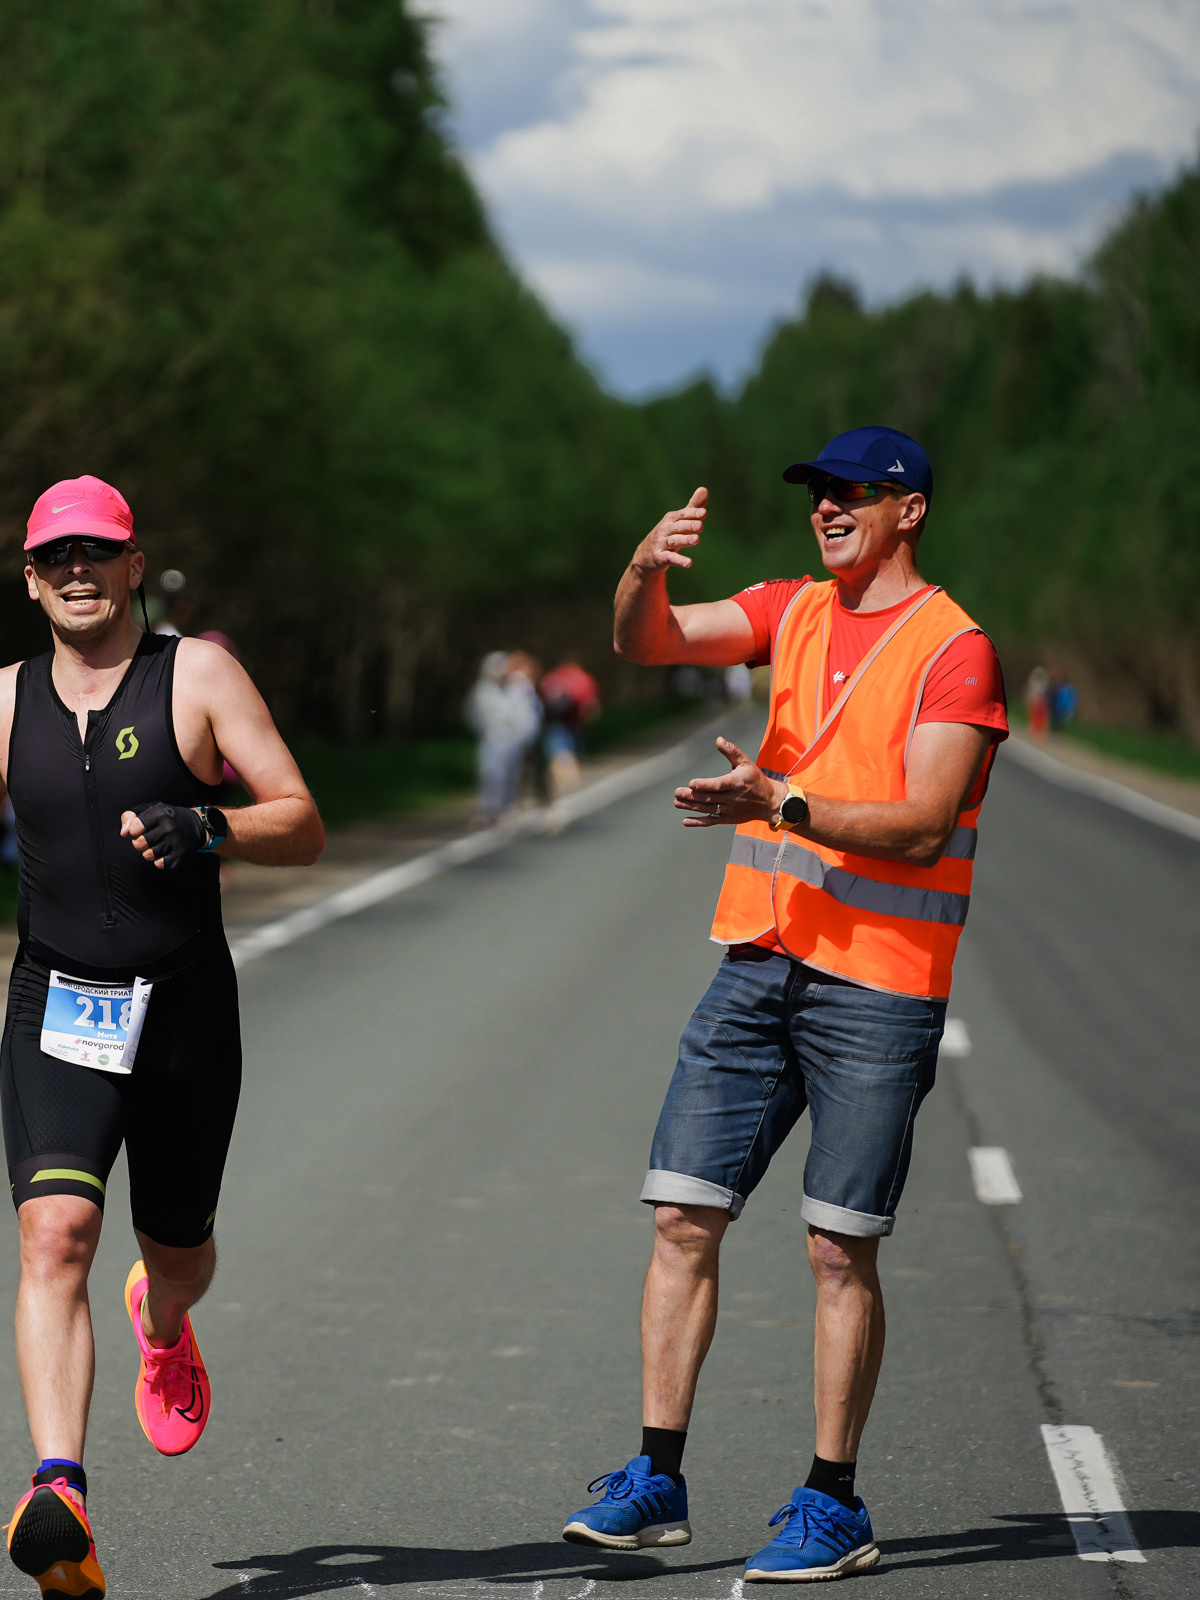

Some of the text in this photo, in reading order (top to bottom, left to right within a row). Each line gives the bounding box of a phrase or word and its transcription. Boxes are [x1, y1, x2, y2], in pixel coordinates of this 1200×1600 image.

[110, 989, 133, 997] ТРИАТ
[97, 1030, 118, 1040] Митя
[75, 1038, 125, 1051] #novgorod
